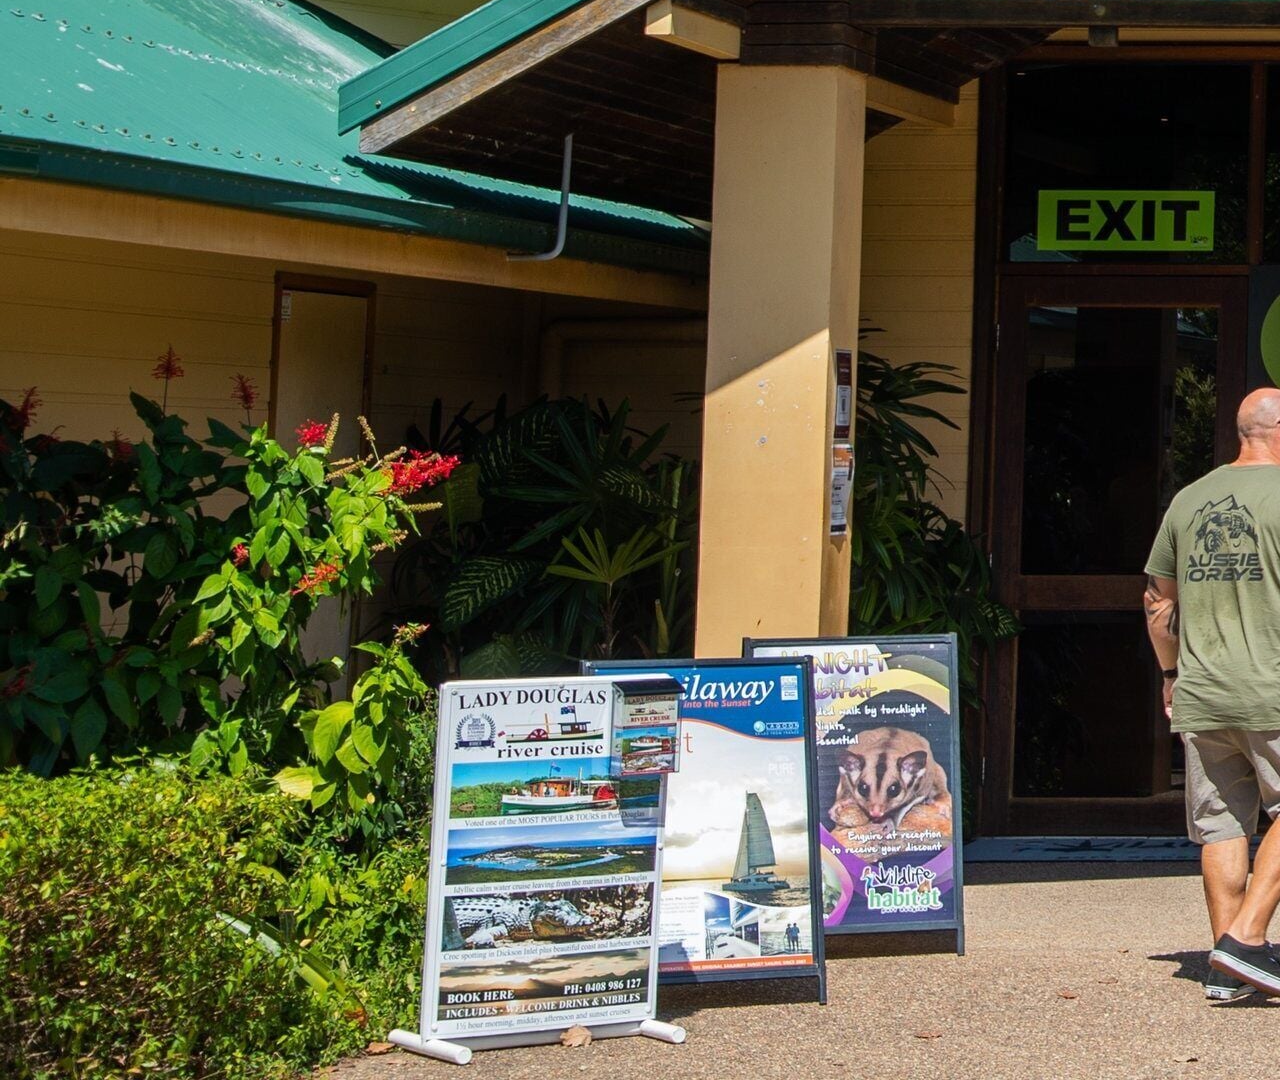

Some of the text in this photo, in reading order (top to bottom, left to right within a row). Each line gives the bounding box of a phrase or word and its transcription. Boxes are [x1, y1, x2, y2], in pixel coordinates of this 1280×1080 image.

[1056, 200, 1200, 241] EXIT
[1187, 552, 1260, 568] AUSSIE
[681, 674, 775, 706] ilaway
[815, 678, 877, 699] bitat
[460, 688, 606, 710] LADY DOUGLAS
[683, 699, 752, 709] into the Sunset
[839, 704, 927, 718] walk by torchlight
[498, 741, 603, 758] river cruise
[464, 819, 483, 827] Voted
[541, 814, 574, 822] POPULAR
[621, 810, 644, 819] Douglas
[848, 829, 942, 842] Enquire at reception
[831, 842, 943, 856] to receive your discount
[453, 886, 473, 894] Idyllic
[532, 880, 554, 889] leaving
[625, 873, 647, 882] Douglas
[868, 887, 943, 910] habitat
[443, 952, 459, 960] Croc
[461, 951, 486, 960] spotting
[496, 947, 521, 956] Dickson
[523, 946, 537, 954] Inlet
[539, 945, 551, 954] plus
[553, 942, 579, 951] beautiful
[563, 978, 641, 994] PH: 0408 986 127
[447, 988, 514, 1003] BOOK HERE
[446, 1005, 497, 1019] INCLUDES
[505, 1000, 556, 1014] WELCOME
[559, 997, 589, 1009] DRINK
[591, 996, 599, 1005] &
[601, 992, 640, 1005] NIBBLES
[467, 1021, 482, 1029] hour
[516, 1015, 541, 1025] midday,
[544, 1012, 574, 1022] afternoon
[589, 1009, 608, 1017] sunset
[610, 1007, 630, 1015] cruises
